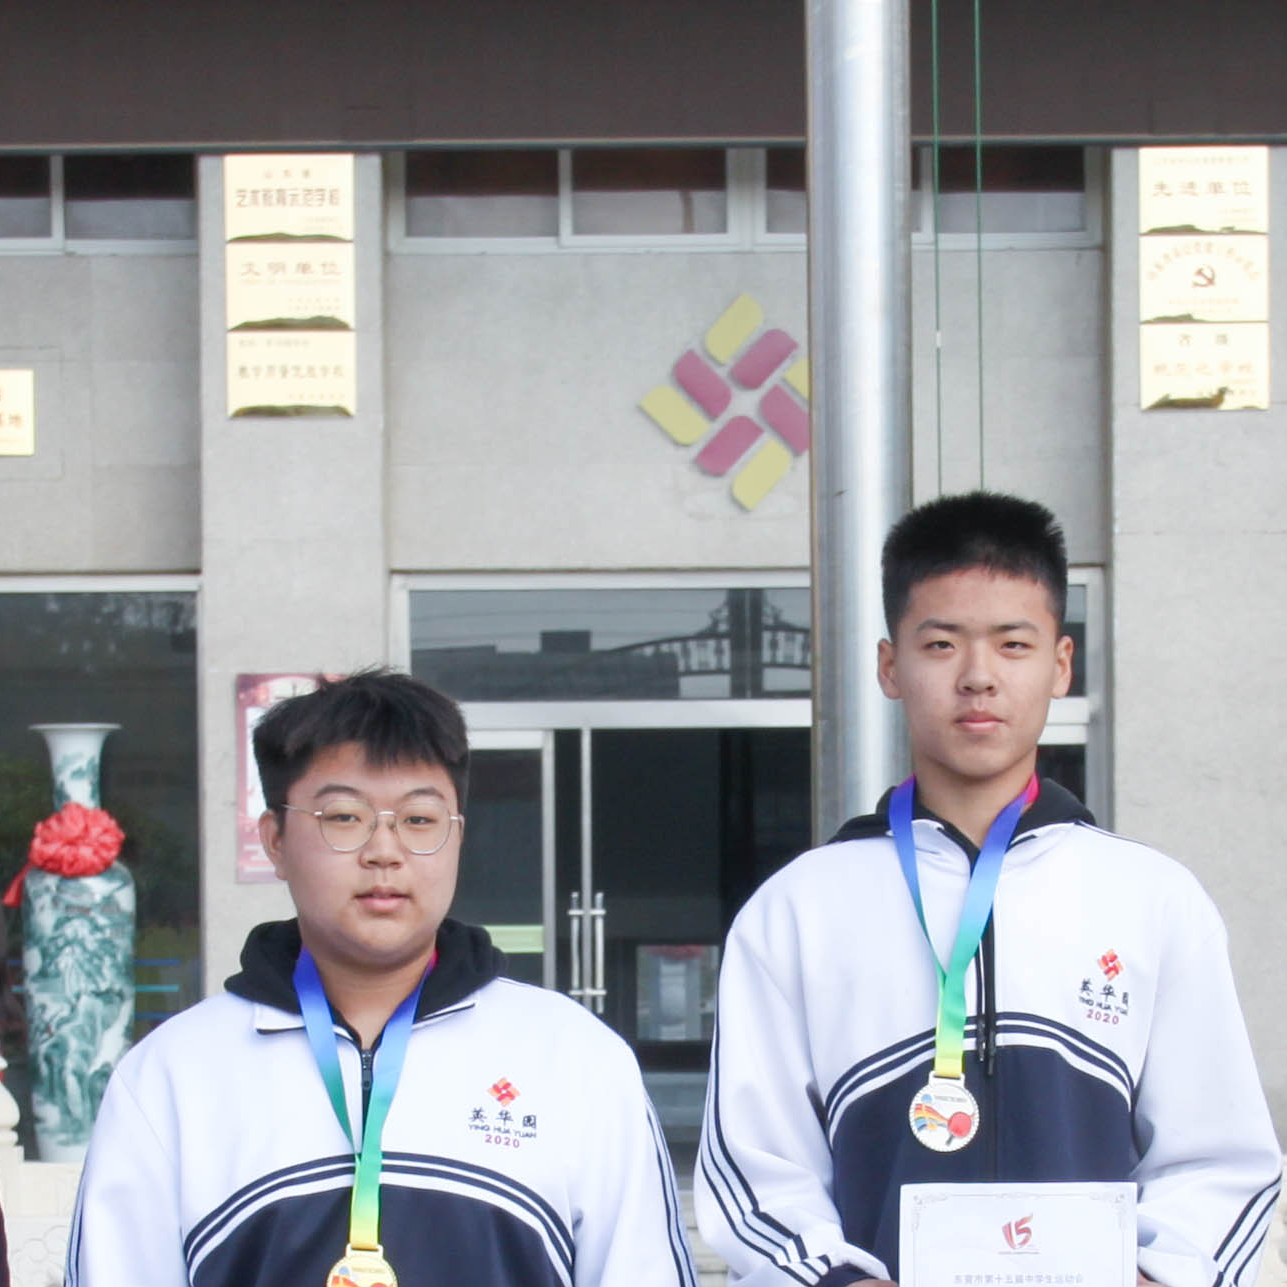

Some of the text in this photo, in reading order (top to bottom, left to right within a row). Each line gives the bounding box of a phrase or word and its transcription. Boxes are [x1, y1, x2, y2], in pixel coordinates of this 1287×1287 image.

[1087, 1010, 1119, 1024] 2020
[468, 1107, 538, 1129] 英华园
[485, 1135, 520, 1148] 2020
